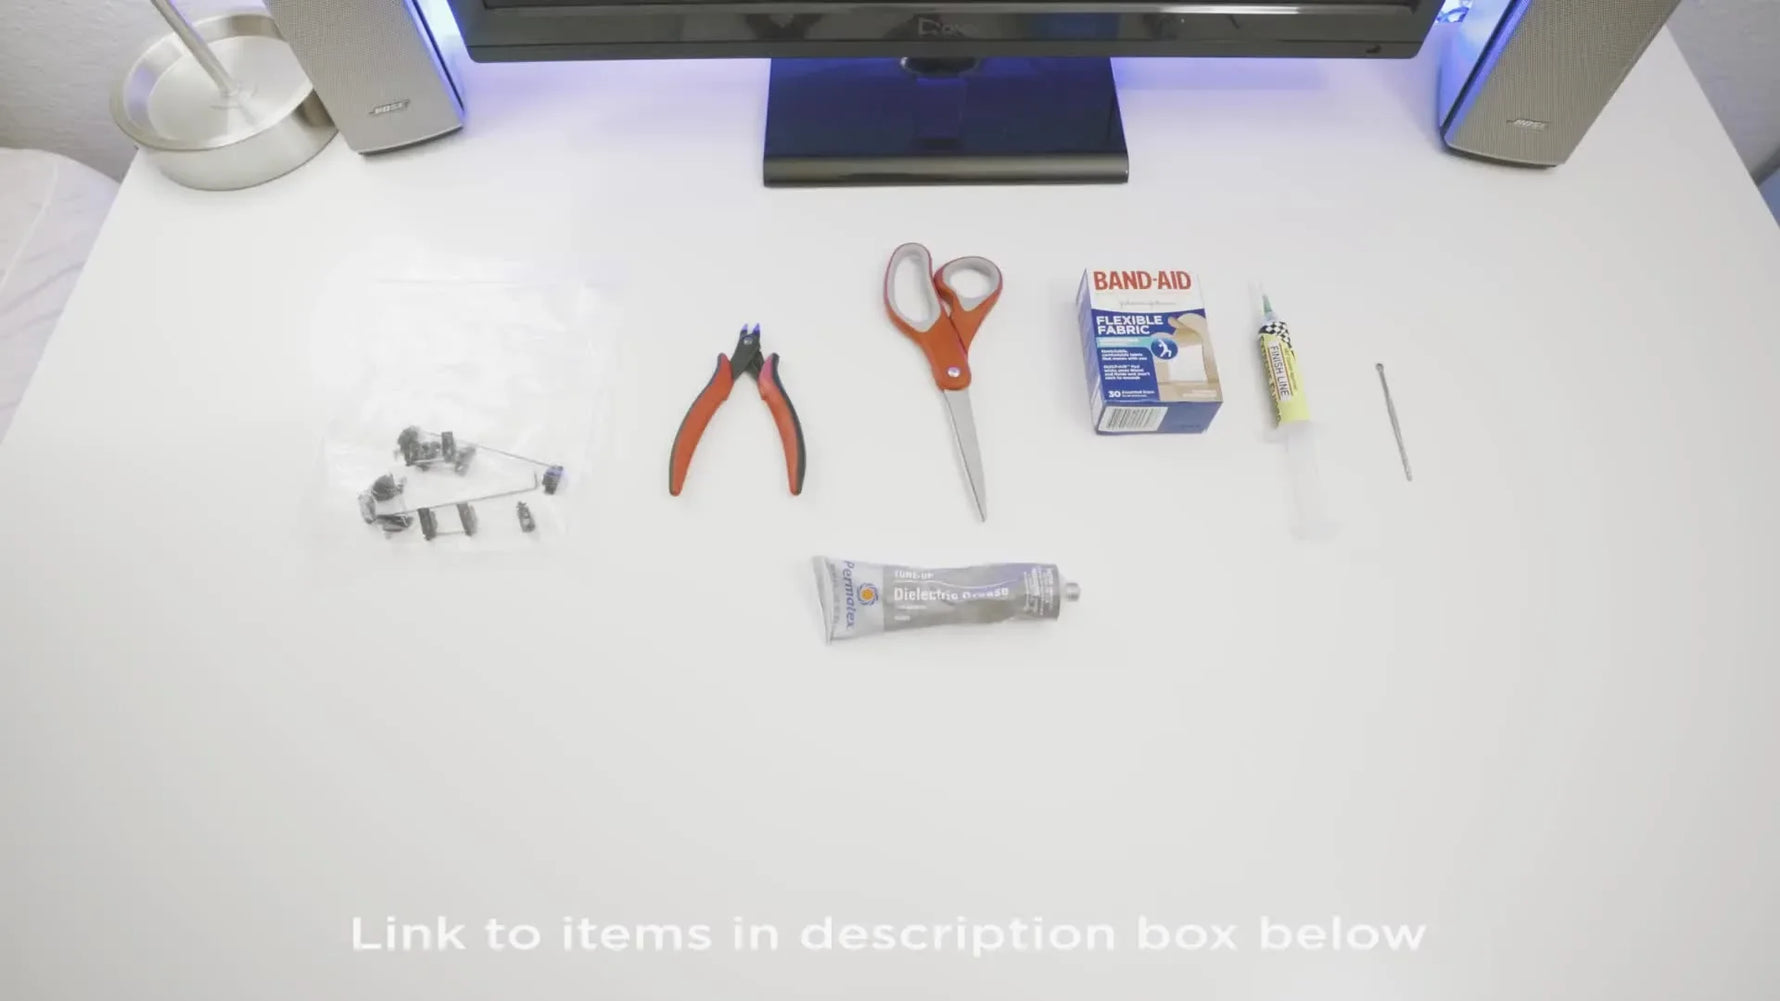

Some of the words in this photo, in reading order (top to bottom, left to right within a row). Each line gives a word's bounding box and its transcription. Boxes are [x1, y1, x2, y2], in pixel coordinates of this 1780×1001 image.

[1093, 271, 1191, 290] BAND-AID
[1096, 315, 1164, 326] FLEXIBLE
[1097, 325, 1151, 335] FABRIC
[1270, 345, 1284, 374] FINISH
[1277, 375, 1290, 396] LINE
[1108, 390, 1121, 398] 30
[842, 560, 856, 629] Permatex
